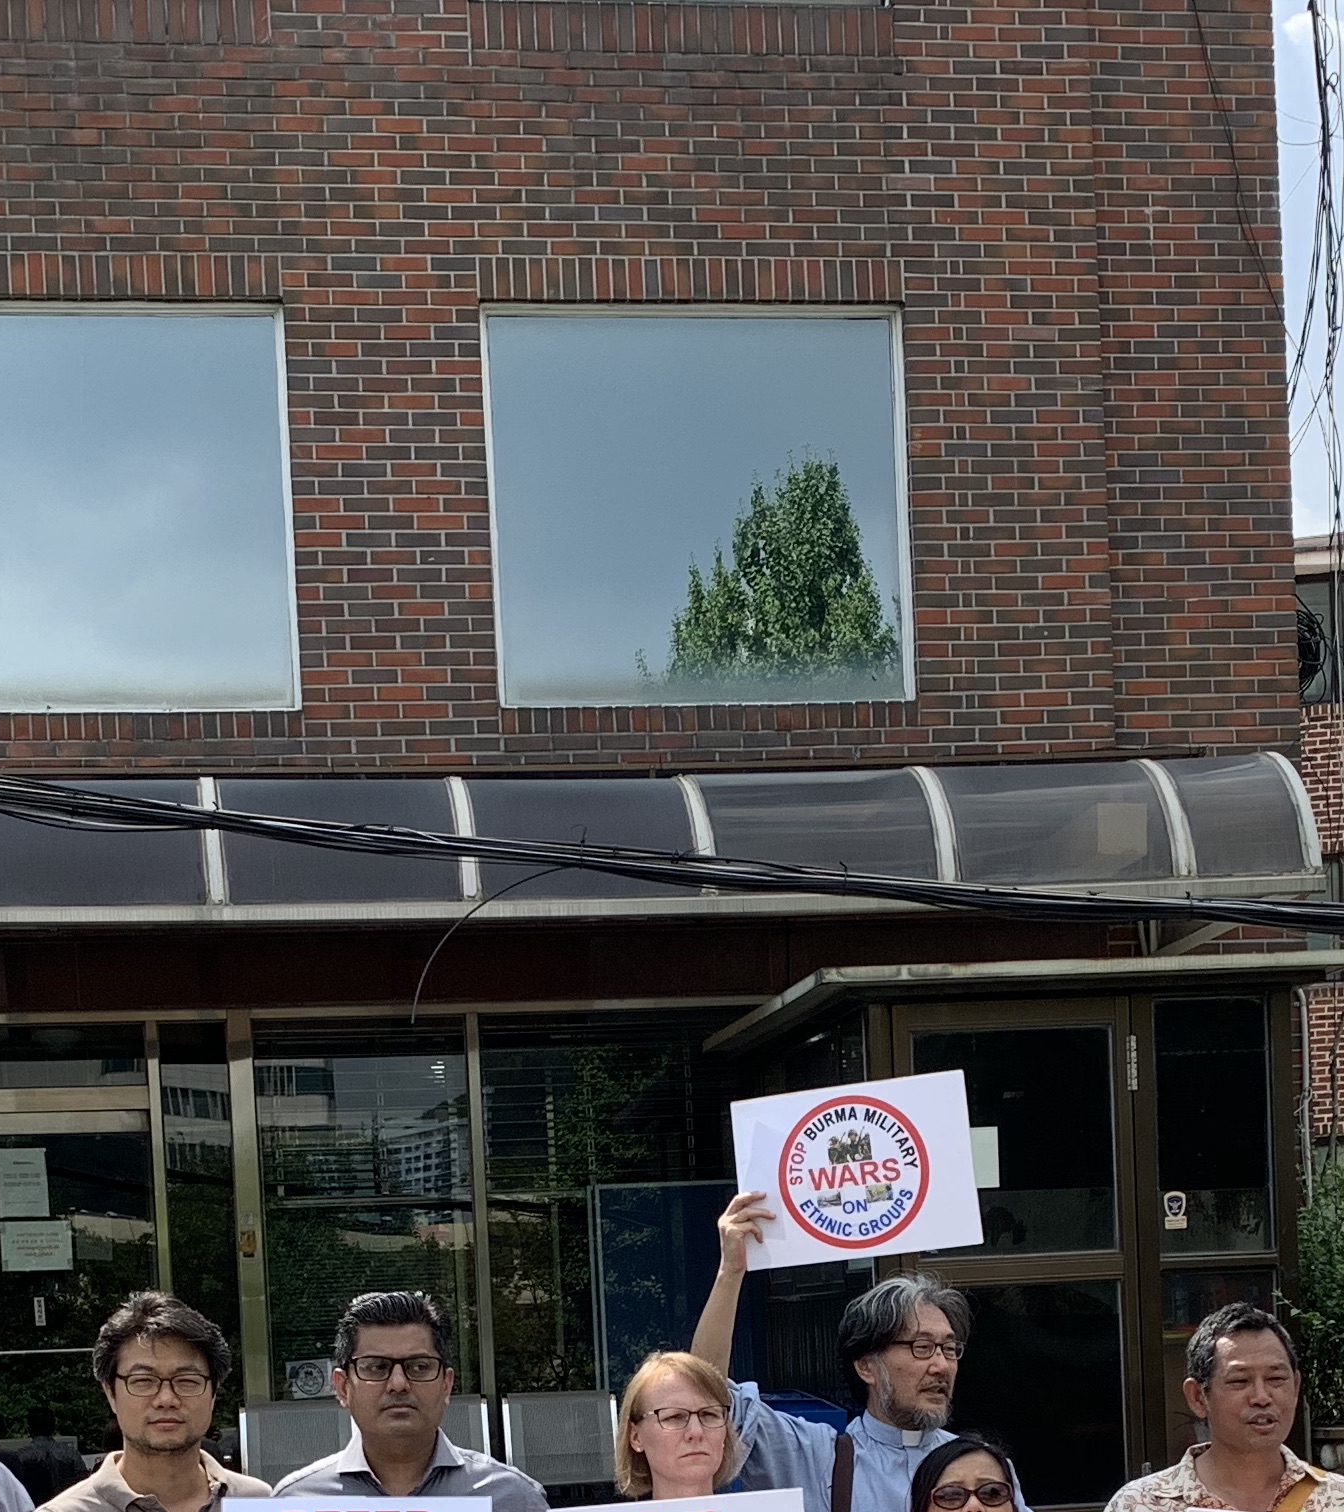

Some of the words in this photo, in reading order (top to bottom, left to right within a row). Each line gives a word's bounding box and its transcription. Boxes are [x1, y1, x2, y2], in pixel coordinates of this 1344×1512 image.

[789, 1141, 807, 1186] STOP
[804, 1106, 857, 1141] BURMA
[863, 1108, 918, 1169] MILITARY
[808, 1157, 901, 1191] WARS
[799, 1199, 853, 1237] ETHNIC
[858, 1188, 914, 1237] GROUPS
[842, 1198, 868, 1215] ON
